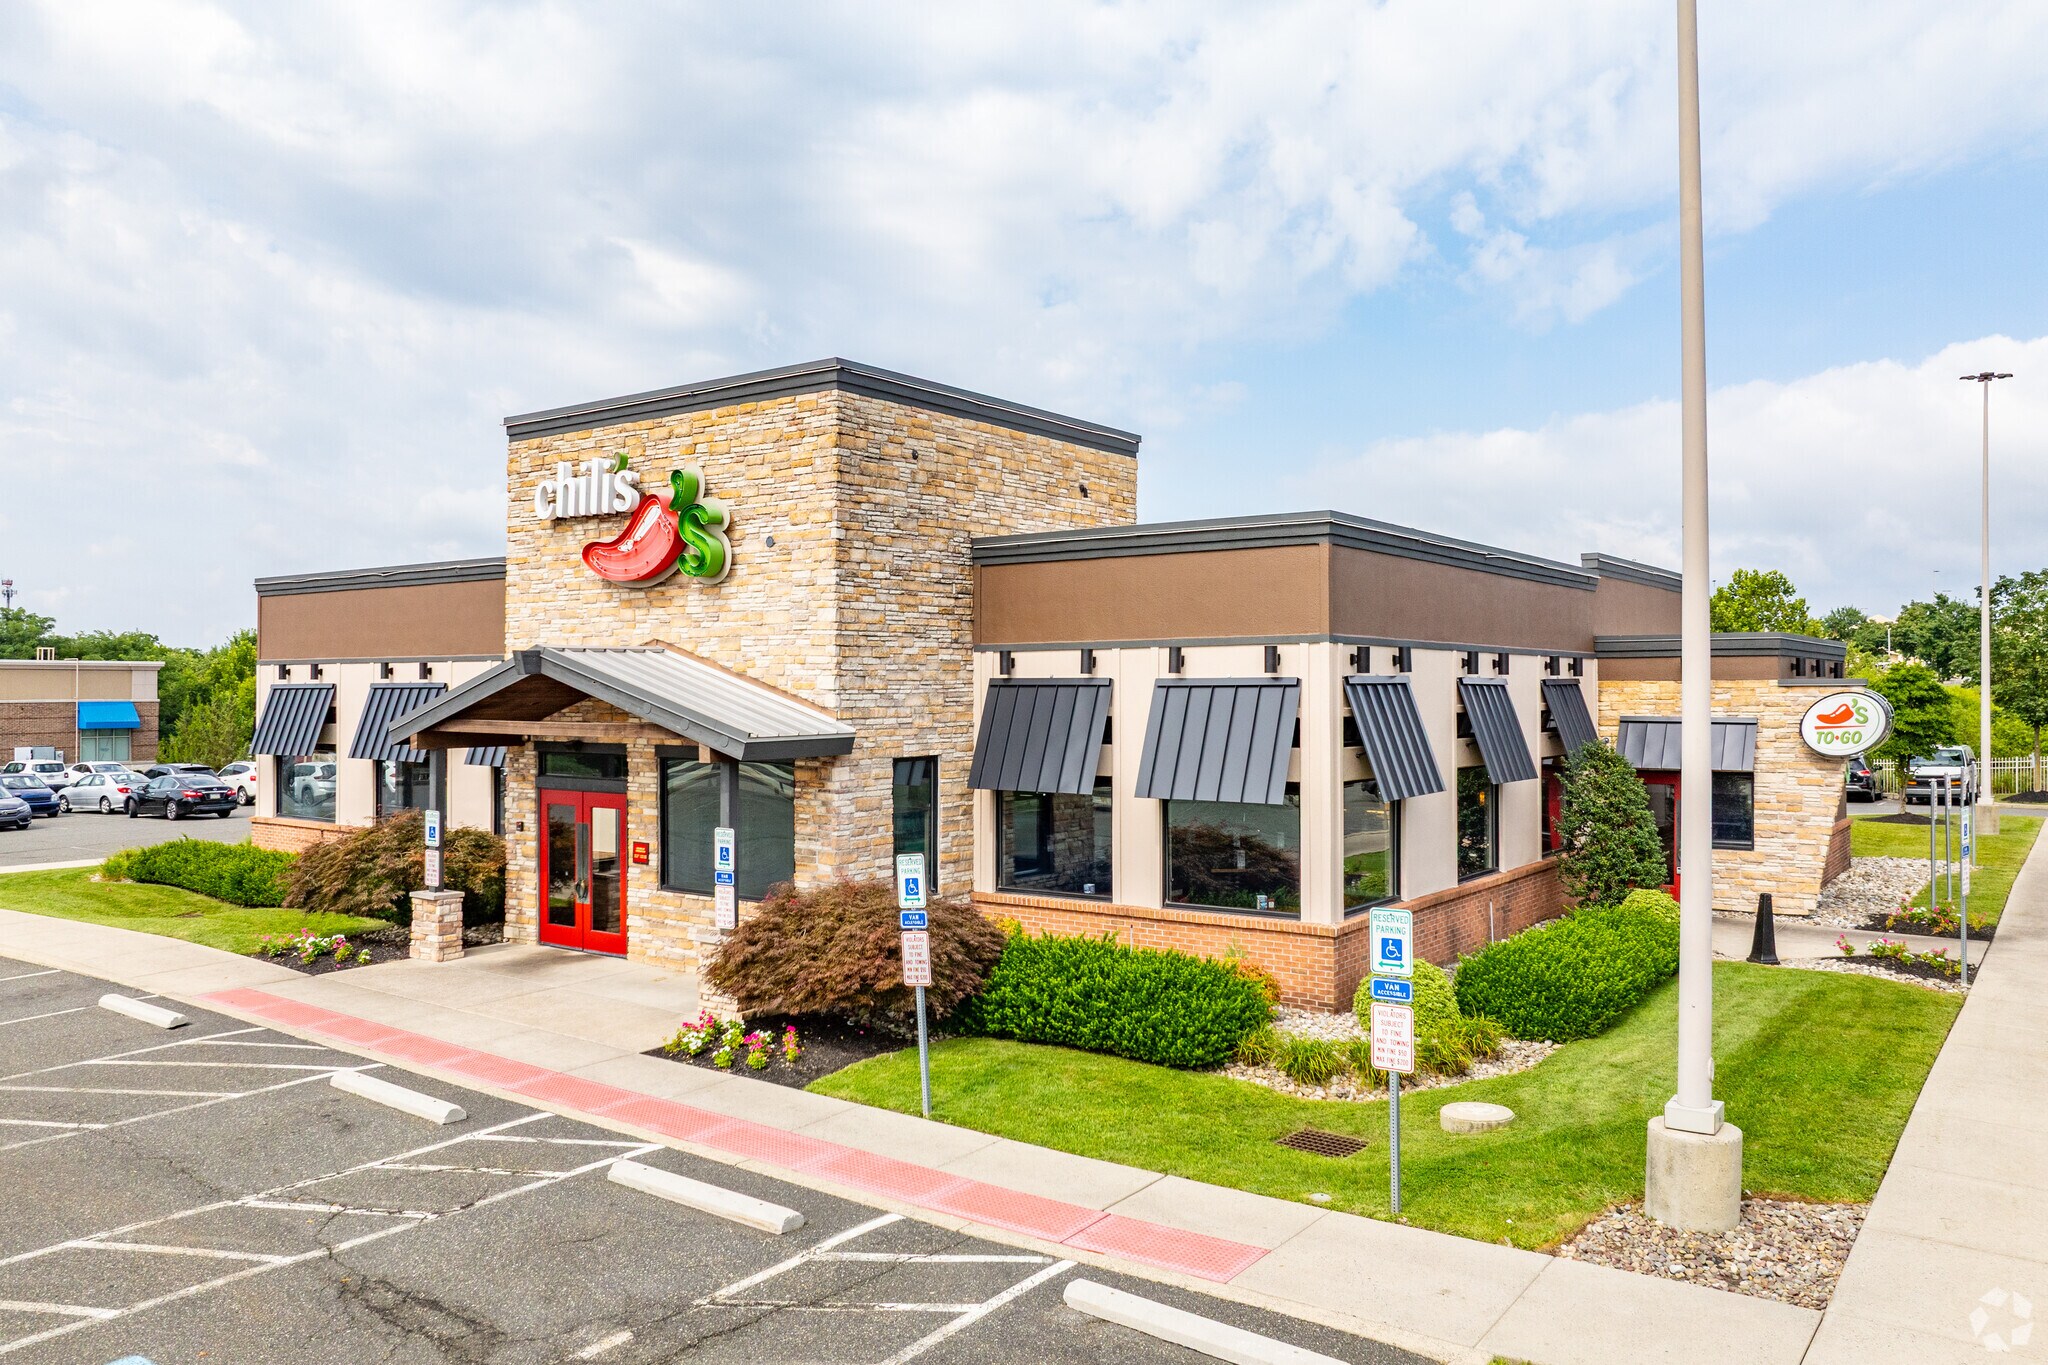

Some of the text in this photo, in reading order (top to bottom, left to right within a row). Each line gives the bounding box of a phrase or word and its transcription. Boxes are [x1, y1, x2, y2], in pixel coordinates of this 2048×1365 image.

[1373, 914, 1409, 924] RESERVED
[1376, 925, 1407, 935] PARKING
[1384, 982, 1400, 991] VAN
[1377, 1010, 1407, 1019] VIOLATORS
[1380, 1020, 1404, 1028] SUBJECT
